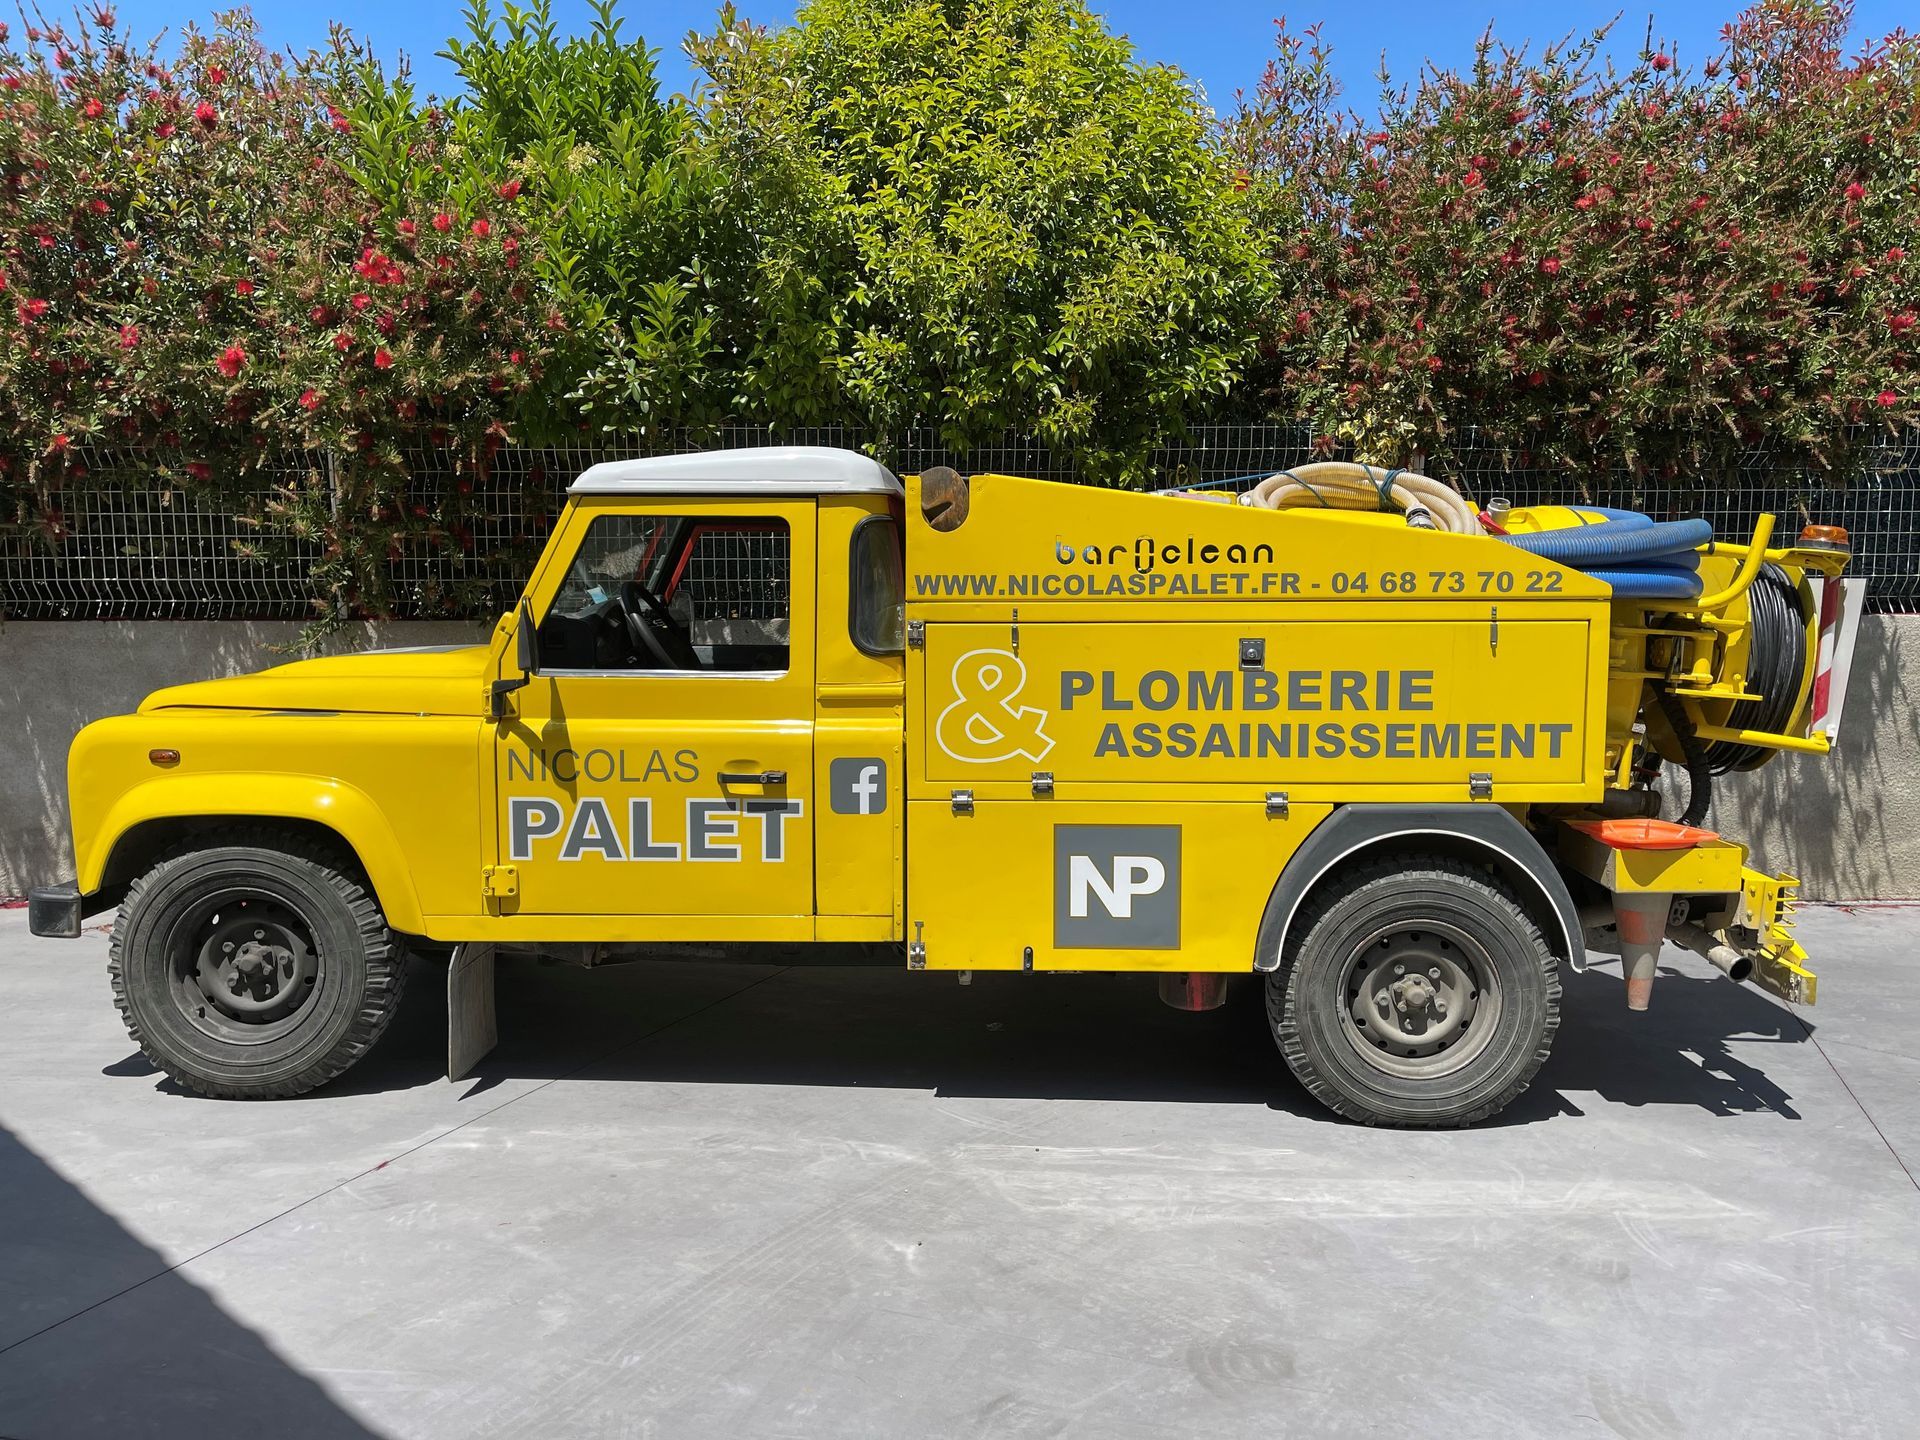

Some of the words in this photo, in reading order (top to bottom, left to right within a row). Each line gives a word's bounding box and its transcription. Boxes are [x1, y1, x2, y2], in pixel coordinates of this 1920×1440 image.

[914, 572, 1300, 596] WWW.NICOLASPALET.FR
[1331, 571, 1368, 594] 04
[1380, 571, 1417, 593] 68
[1430, 571, 1465, 593] 73
[1478, 571, 1514, 593] 70
[1527, 570, 1563, 593] 22
[936, 648, 1056, 763] &
[1060, 670, 1434, 711] PLOMBERIE
[1094, 722, 1573, 759] ASSAINISSEMENT
[507, 749, 699, 783] NICOLAS
[852, 765, 879, 815] f
[508, 796, 804, 863] PALET
[1070, 855, 1166, 917] NP
